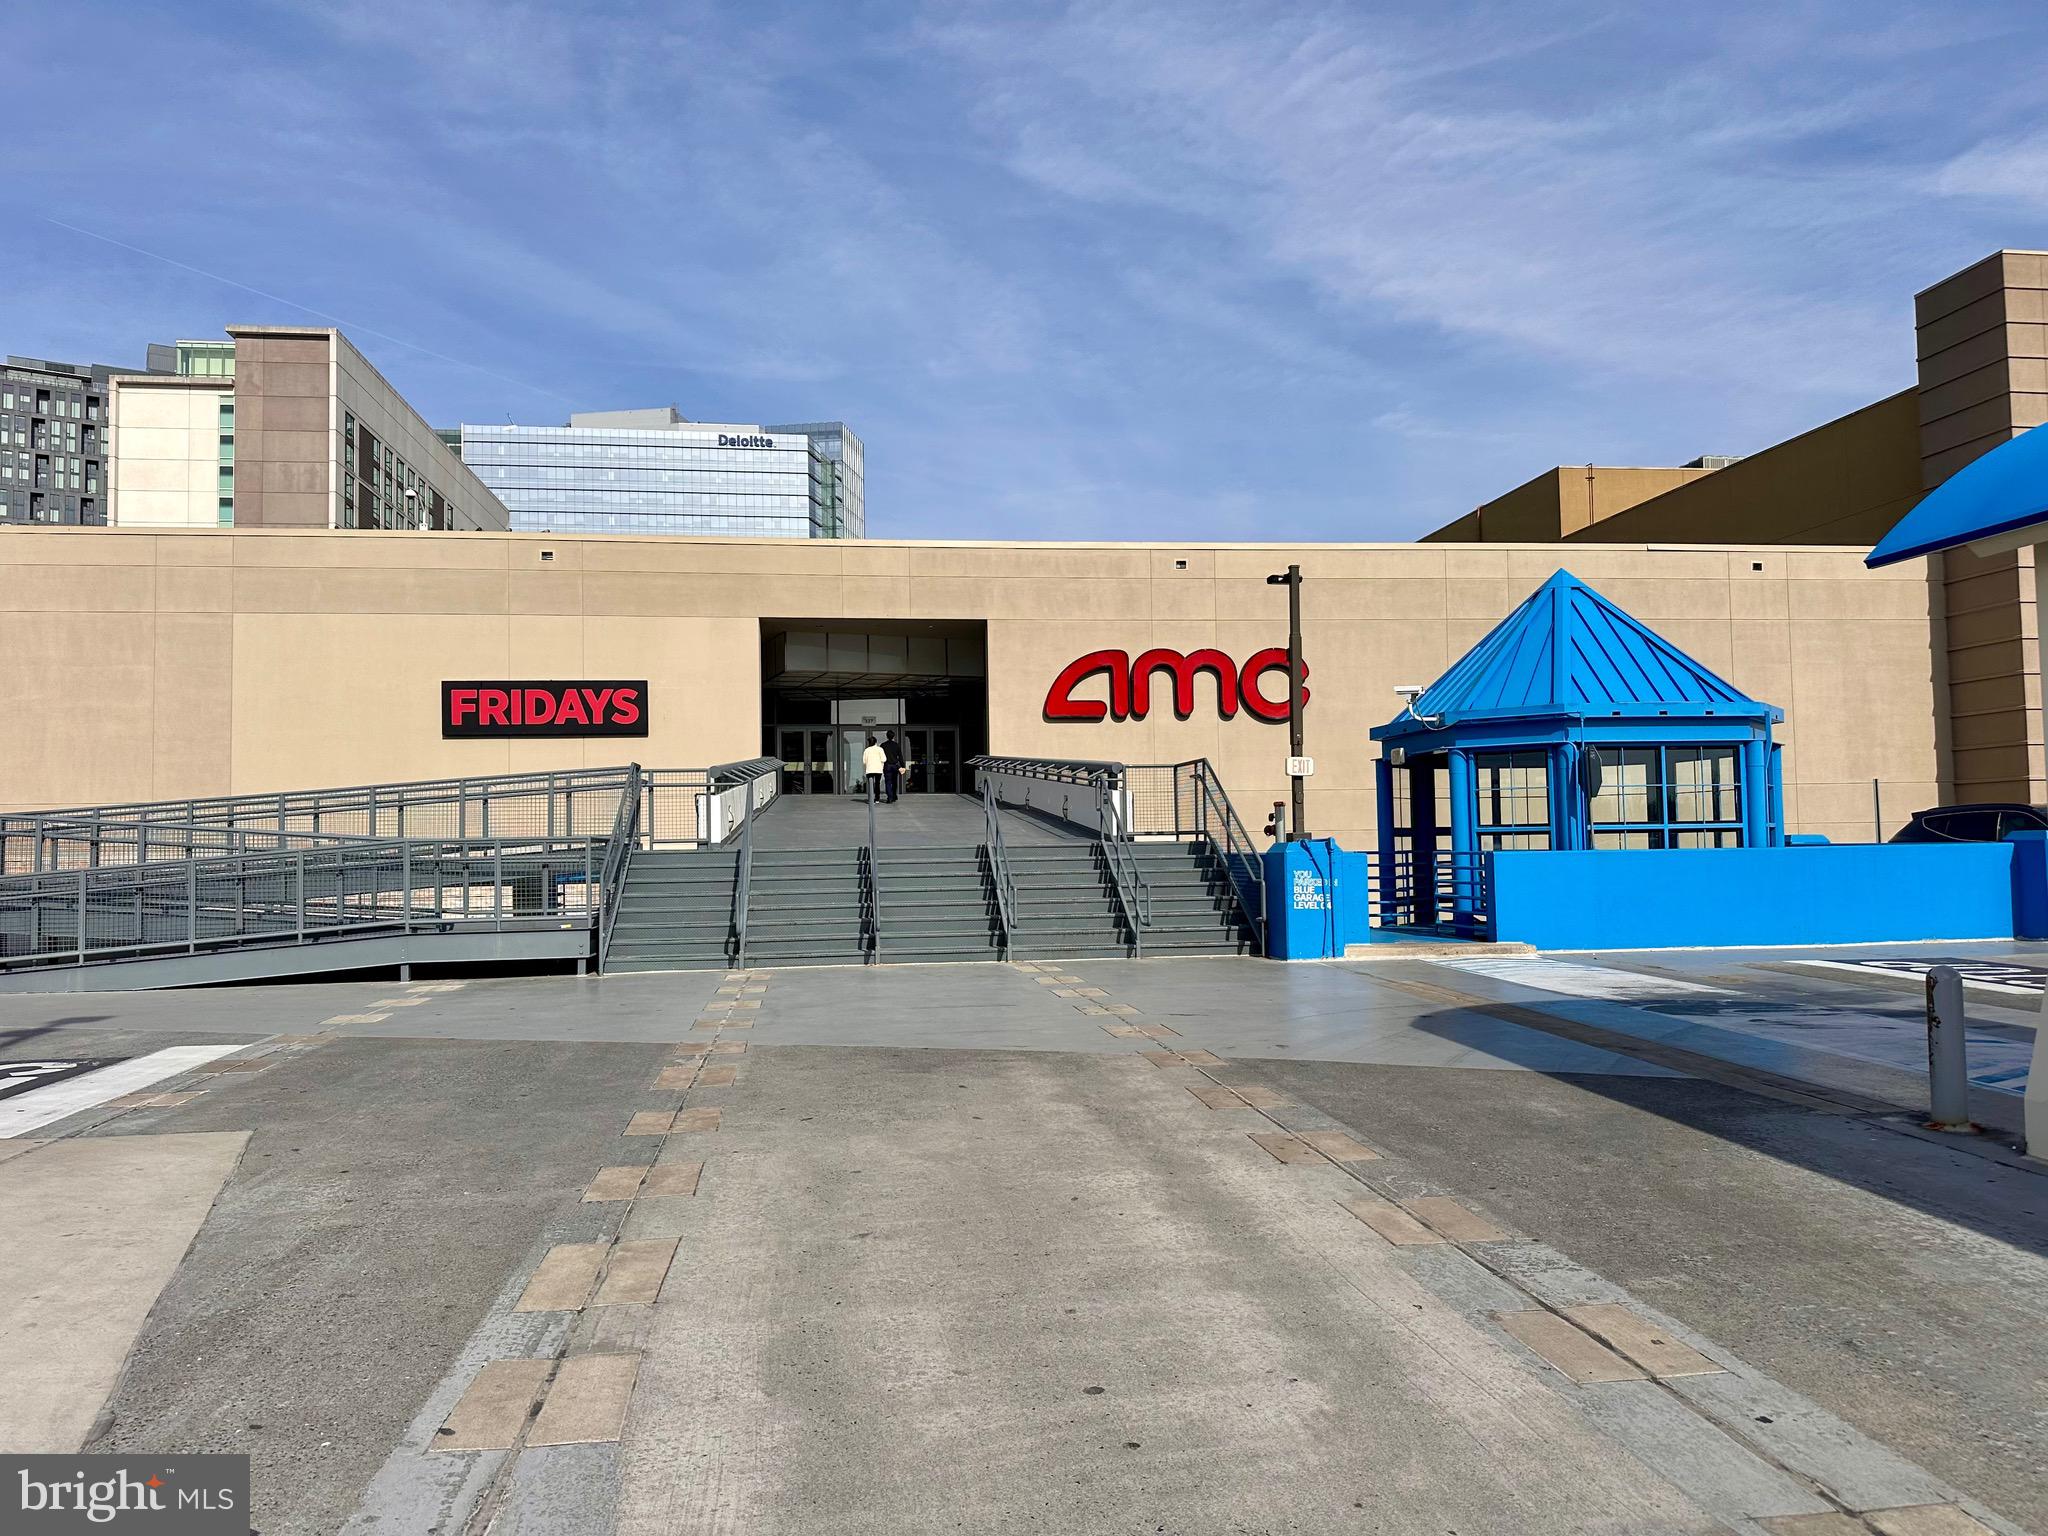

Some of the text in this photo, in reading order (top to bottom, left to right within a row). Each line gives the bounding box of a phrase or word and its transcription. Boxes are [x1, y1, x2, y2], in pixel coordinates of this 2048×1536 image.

[451, 688, 640, 725] FRIDAYS
[1292, 759, 1311, 774] EXIT
[1293, 870, 1312, 879] YOU
[1294, 886, 1315, 894] BLUE
[1294, 901, 1320, 910] LEVEL
